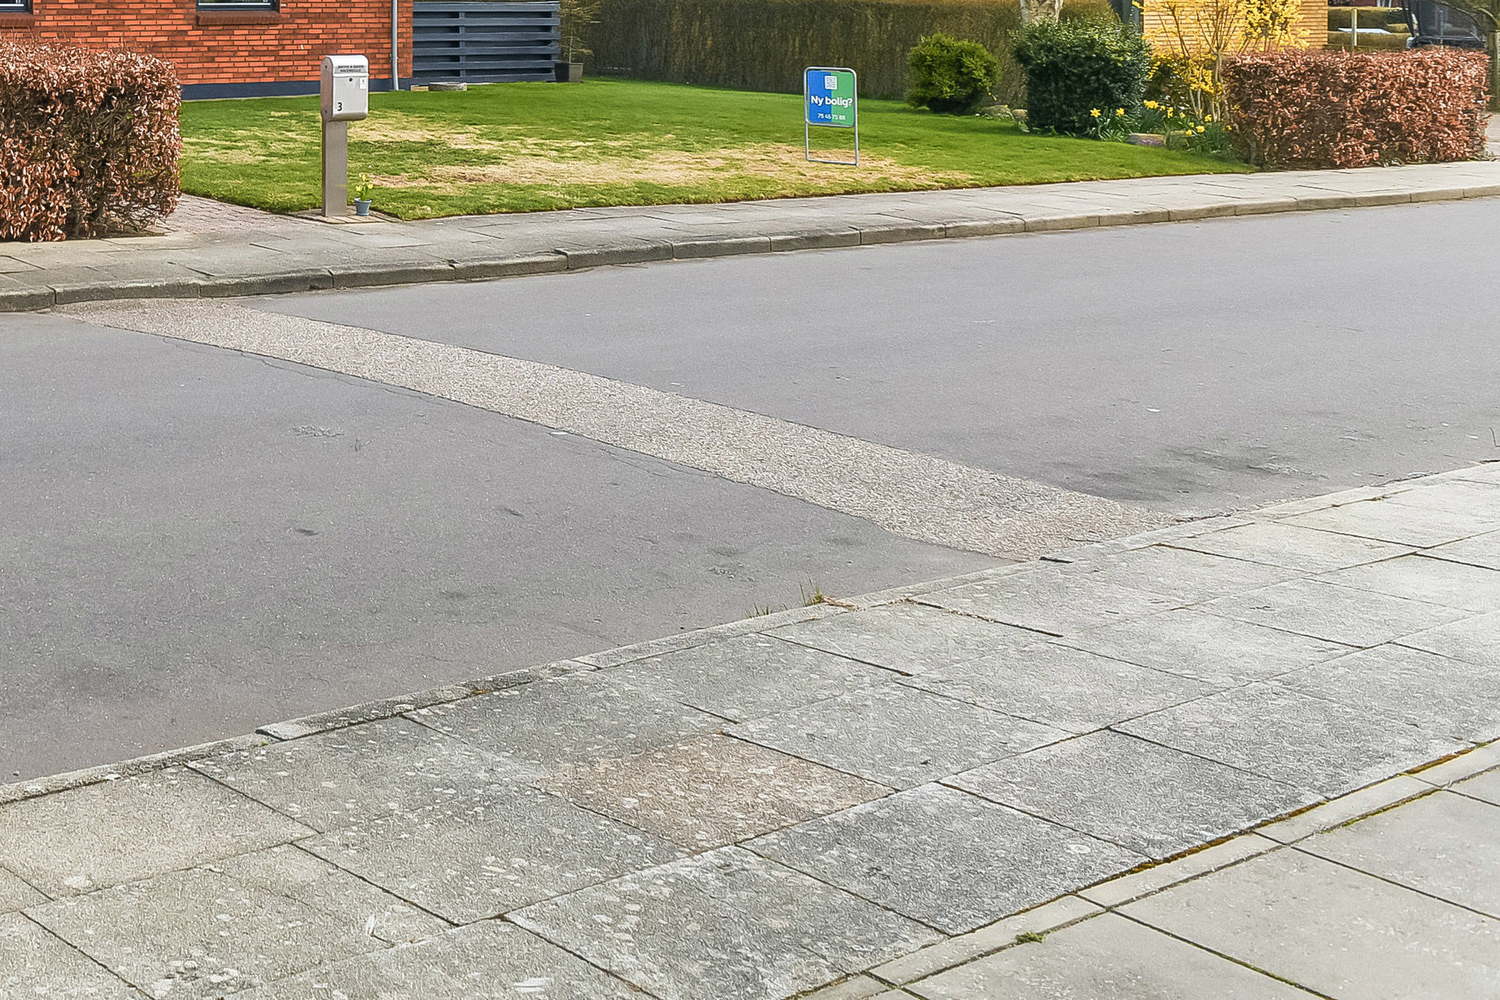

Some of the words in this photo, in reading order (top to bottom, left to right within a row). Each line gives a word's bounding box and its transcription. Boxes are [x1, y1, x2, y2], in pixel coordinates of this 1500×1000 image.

[337, 102, 343, 111] 3
[810, 95, 824, 106] Ny
[825, 96, 853, 108] bolig?
